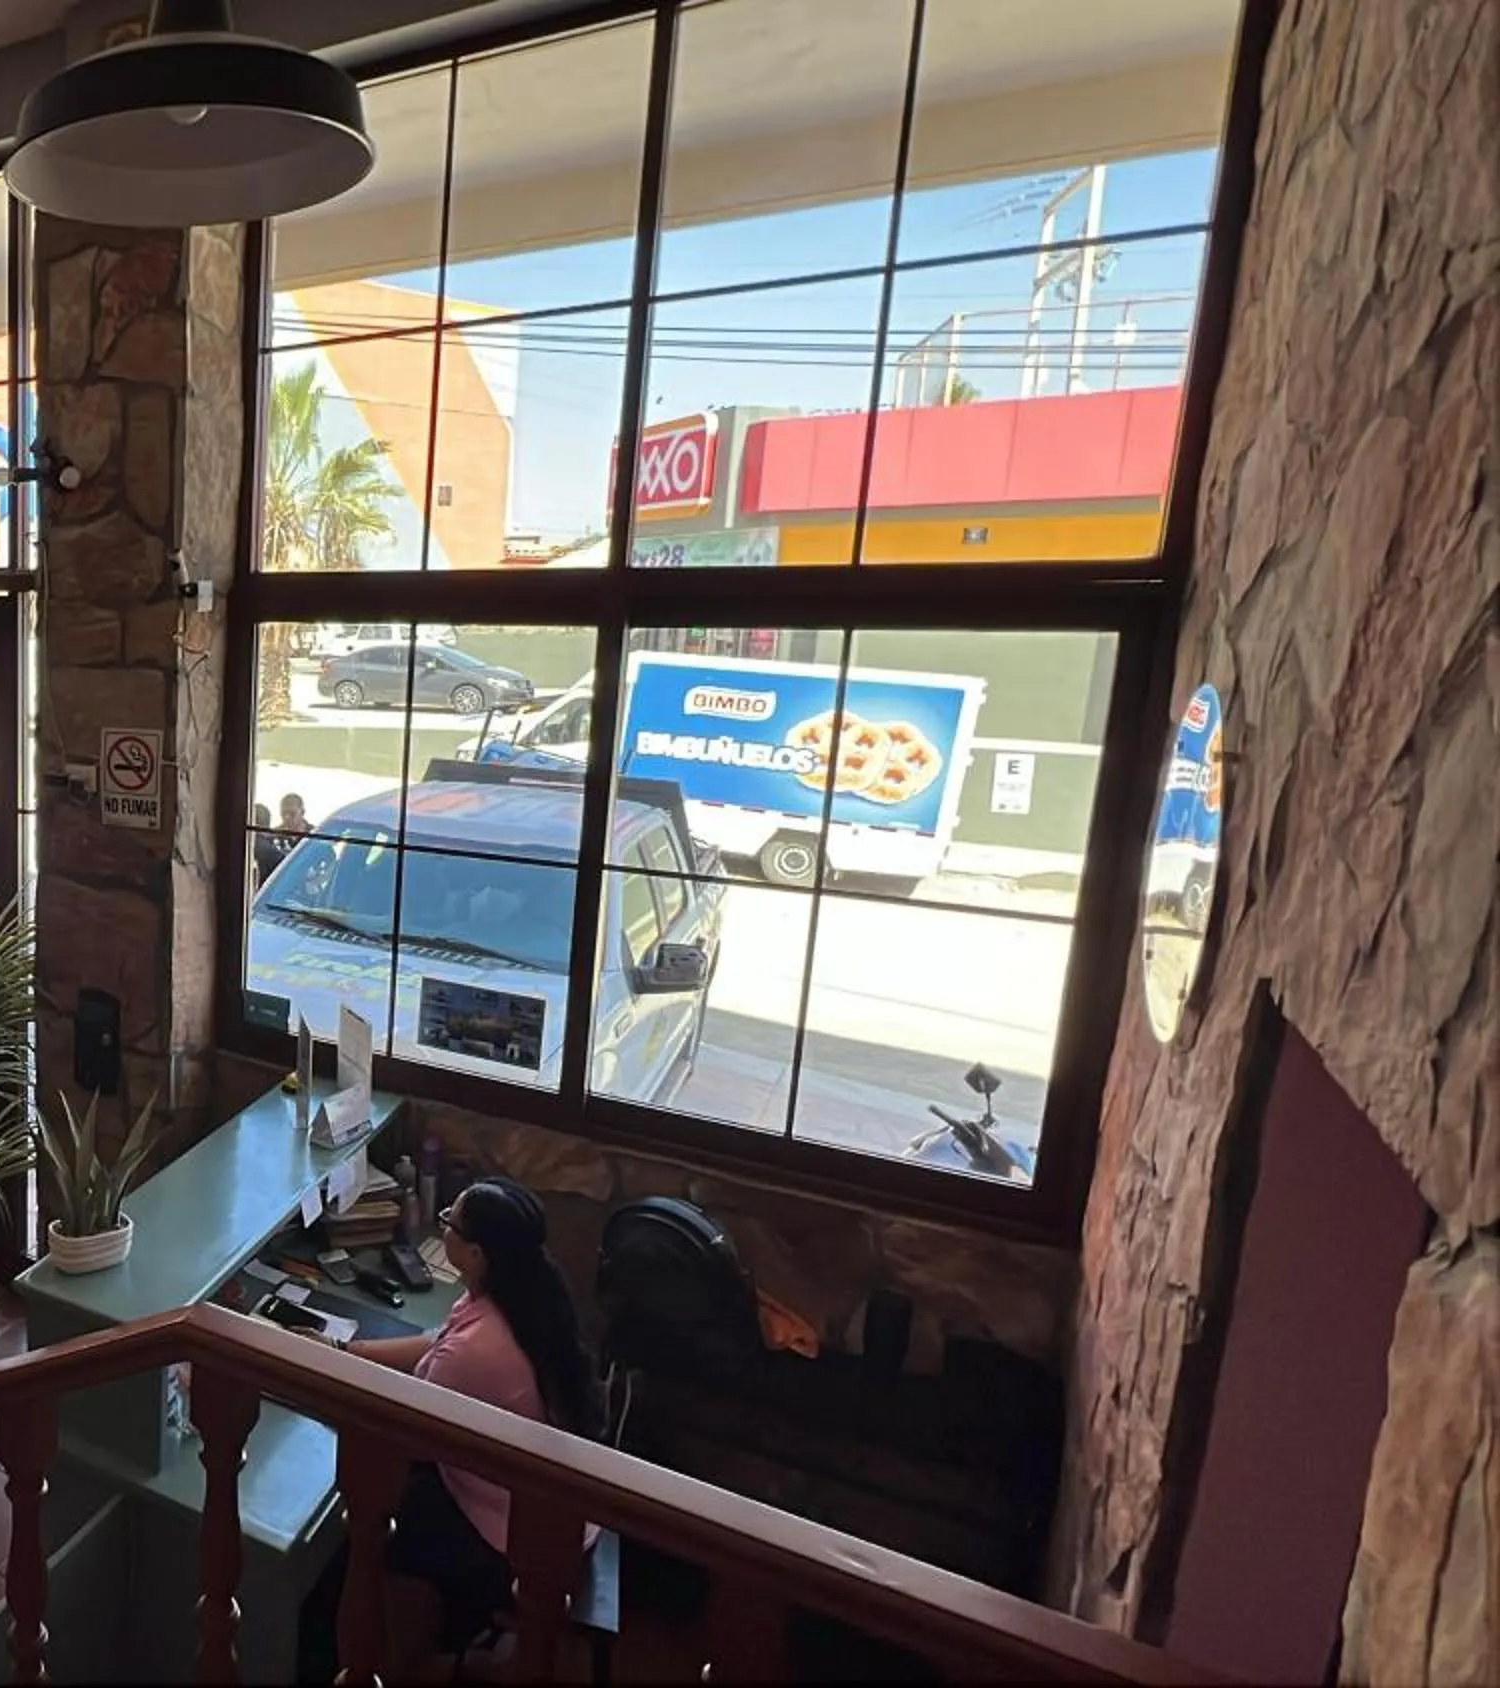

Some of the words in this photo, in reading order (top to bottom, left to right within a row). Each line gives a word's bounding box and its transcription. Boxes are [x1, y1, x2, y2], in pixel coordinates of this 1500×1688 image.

[693, 694, 767, 714] BIMBO
[636, 731, 815, 774] BIMBUÑUELOS
[1008, 759, 1021, 775] E
[104, 797, 119, 813] NO
[121, 798, 157, 817] FUMAR
